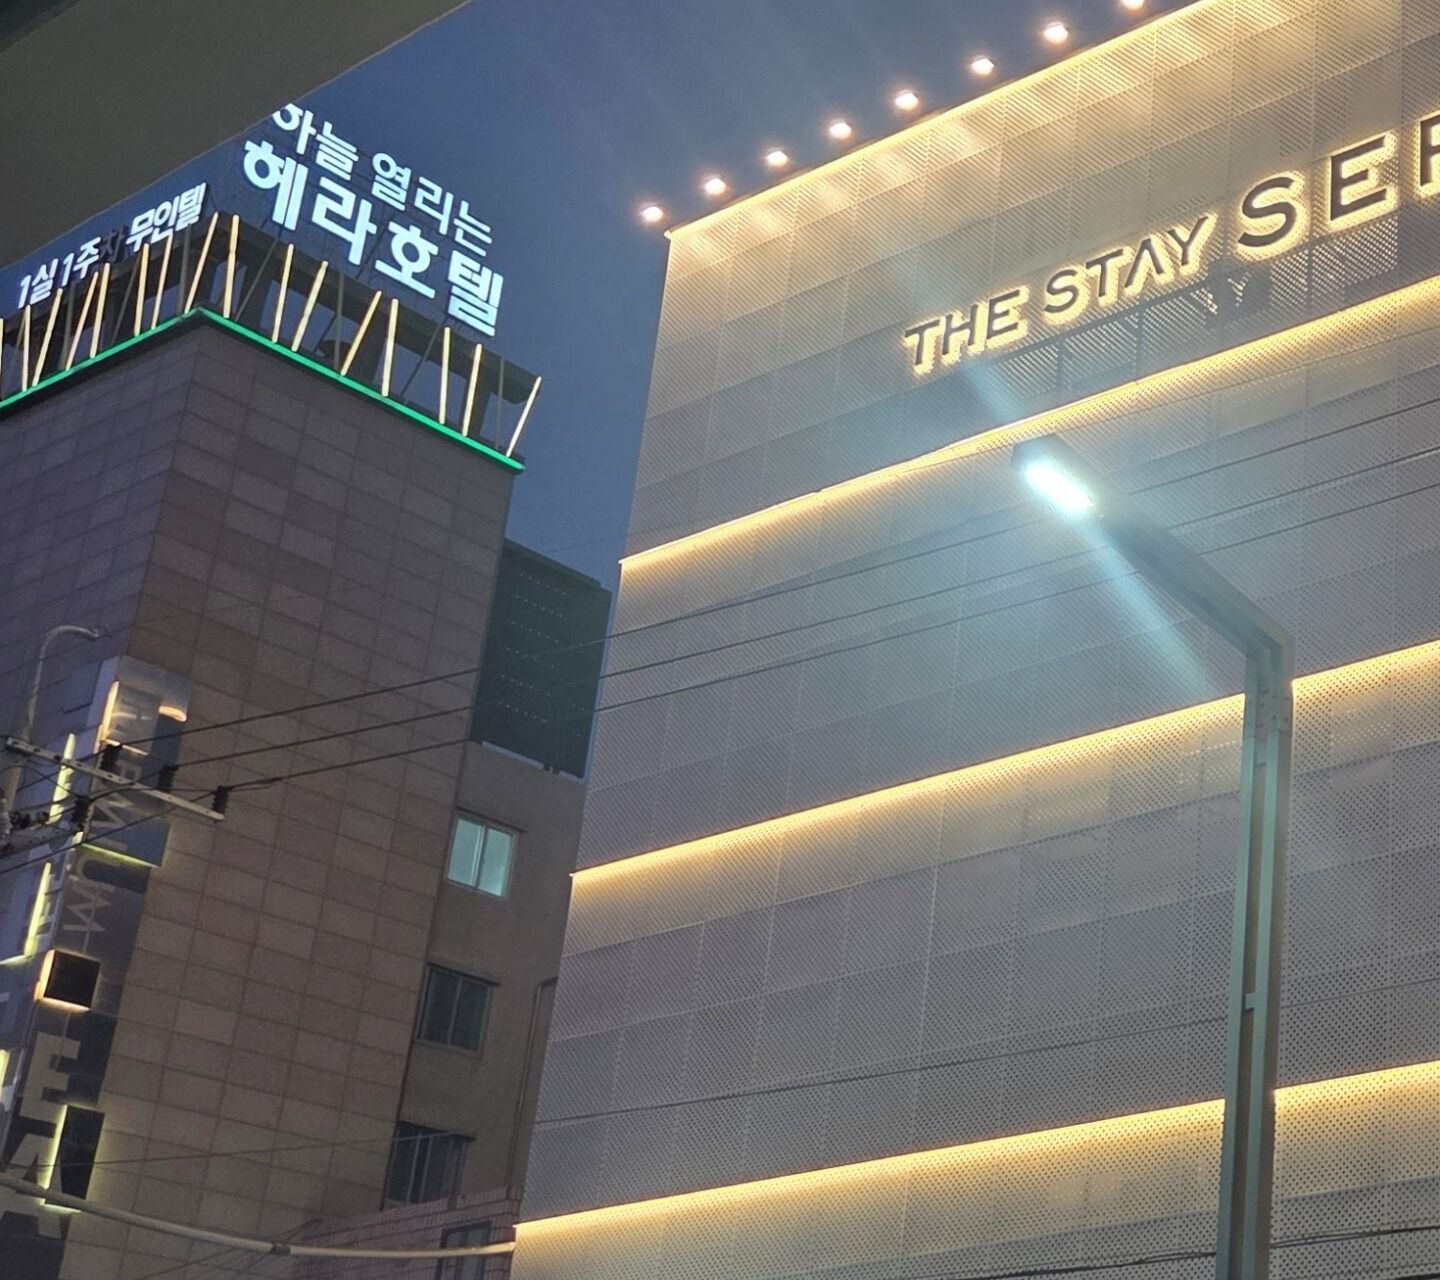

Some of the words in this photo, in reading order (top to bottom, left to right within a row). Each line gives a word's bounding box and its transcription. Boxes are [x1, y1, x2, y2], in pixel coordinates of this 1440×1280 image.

[18, 258, 59, 309] 1실
[125, 182, 207, 252] 무인텔
[243, 140, 504, 337] 헤라호텔
[272, 103, 359, 181] 하늘
[371, 152, 493, 257] 열리는
[904, 287, 1024, 372] THE
[1043, 214, 1214, 318] STAY
